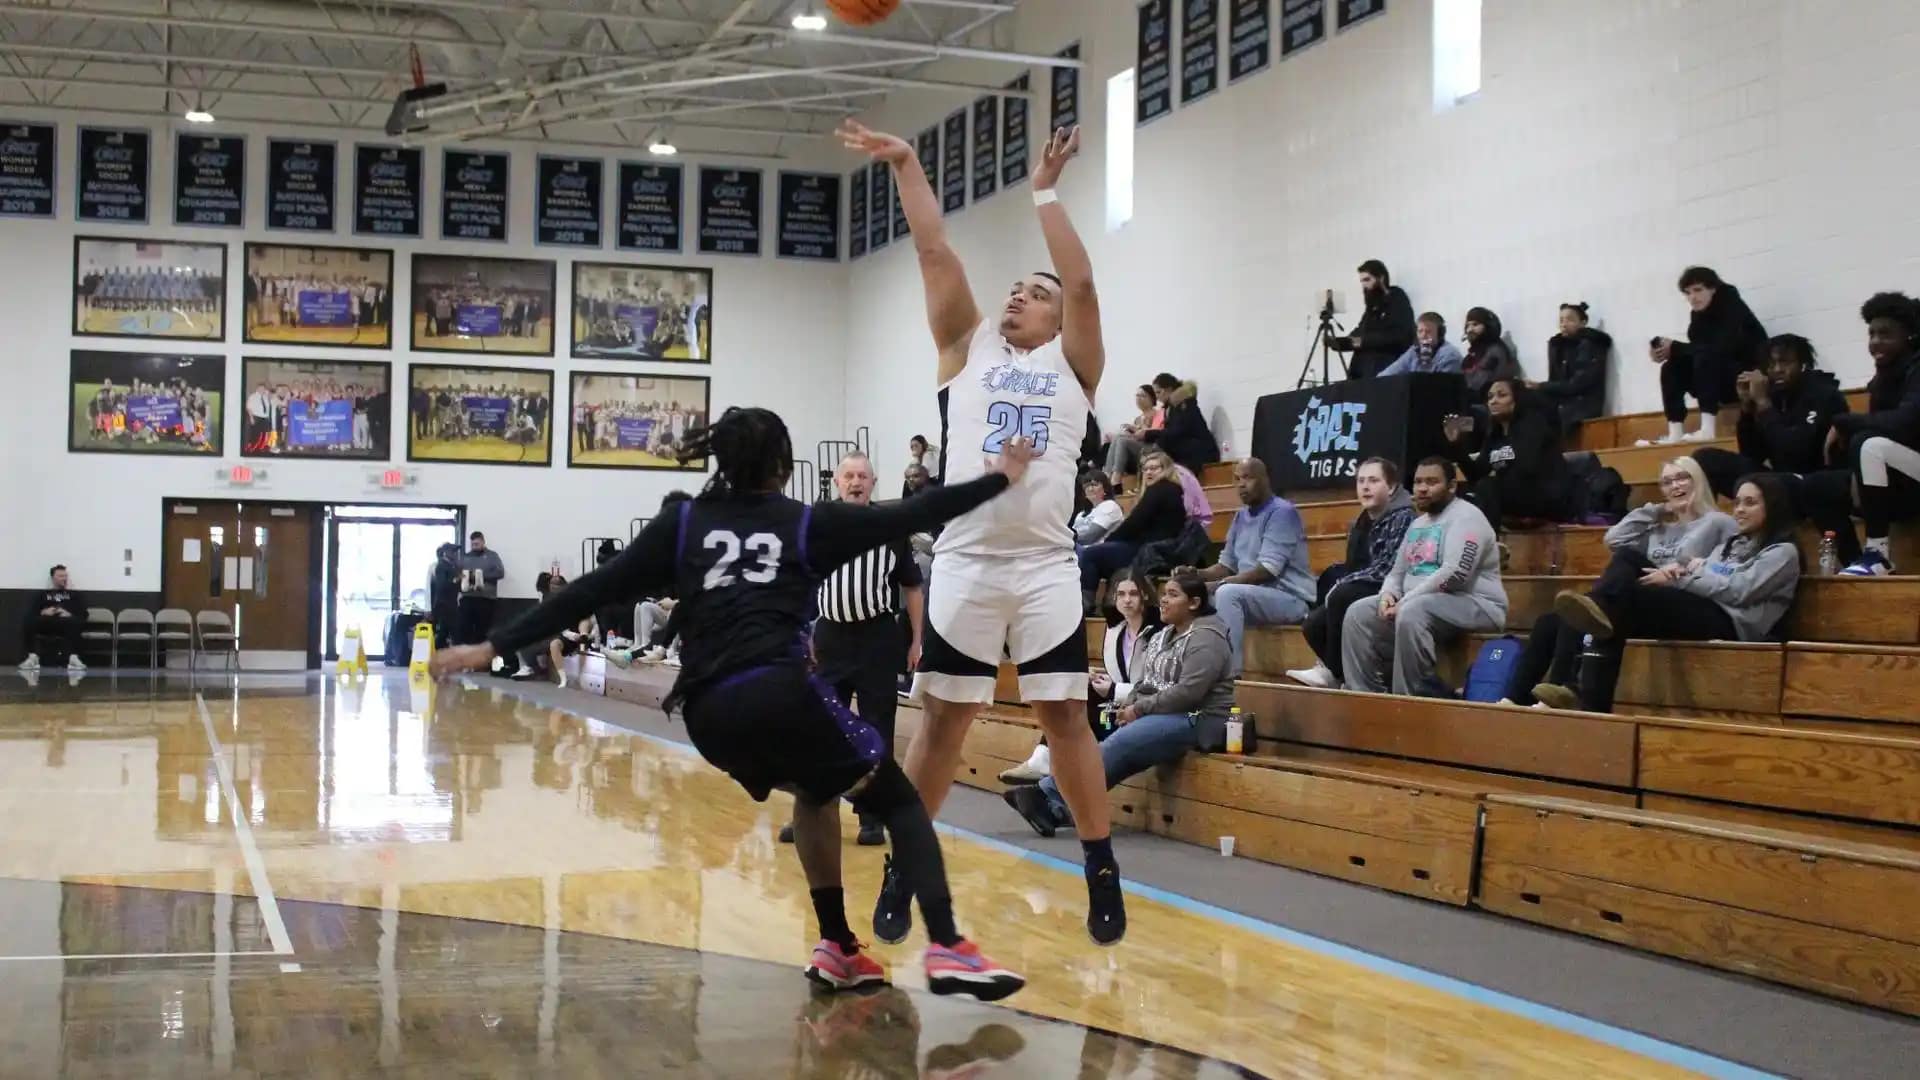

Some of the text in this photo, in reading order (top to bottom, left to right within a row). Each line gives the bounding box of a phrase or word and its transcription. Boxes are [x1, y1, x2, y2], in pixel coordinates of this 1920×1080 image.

[981, 364, 1059, 397] GRACE
[983, 401, 1052, 458] 25
[703, 530, 783, 590] 23
